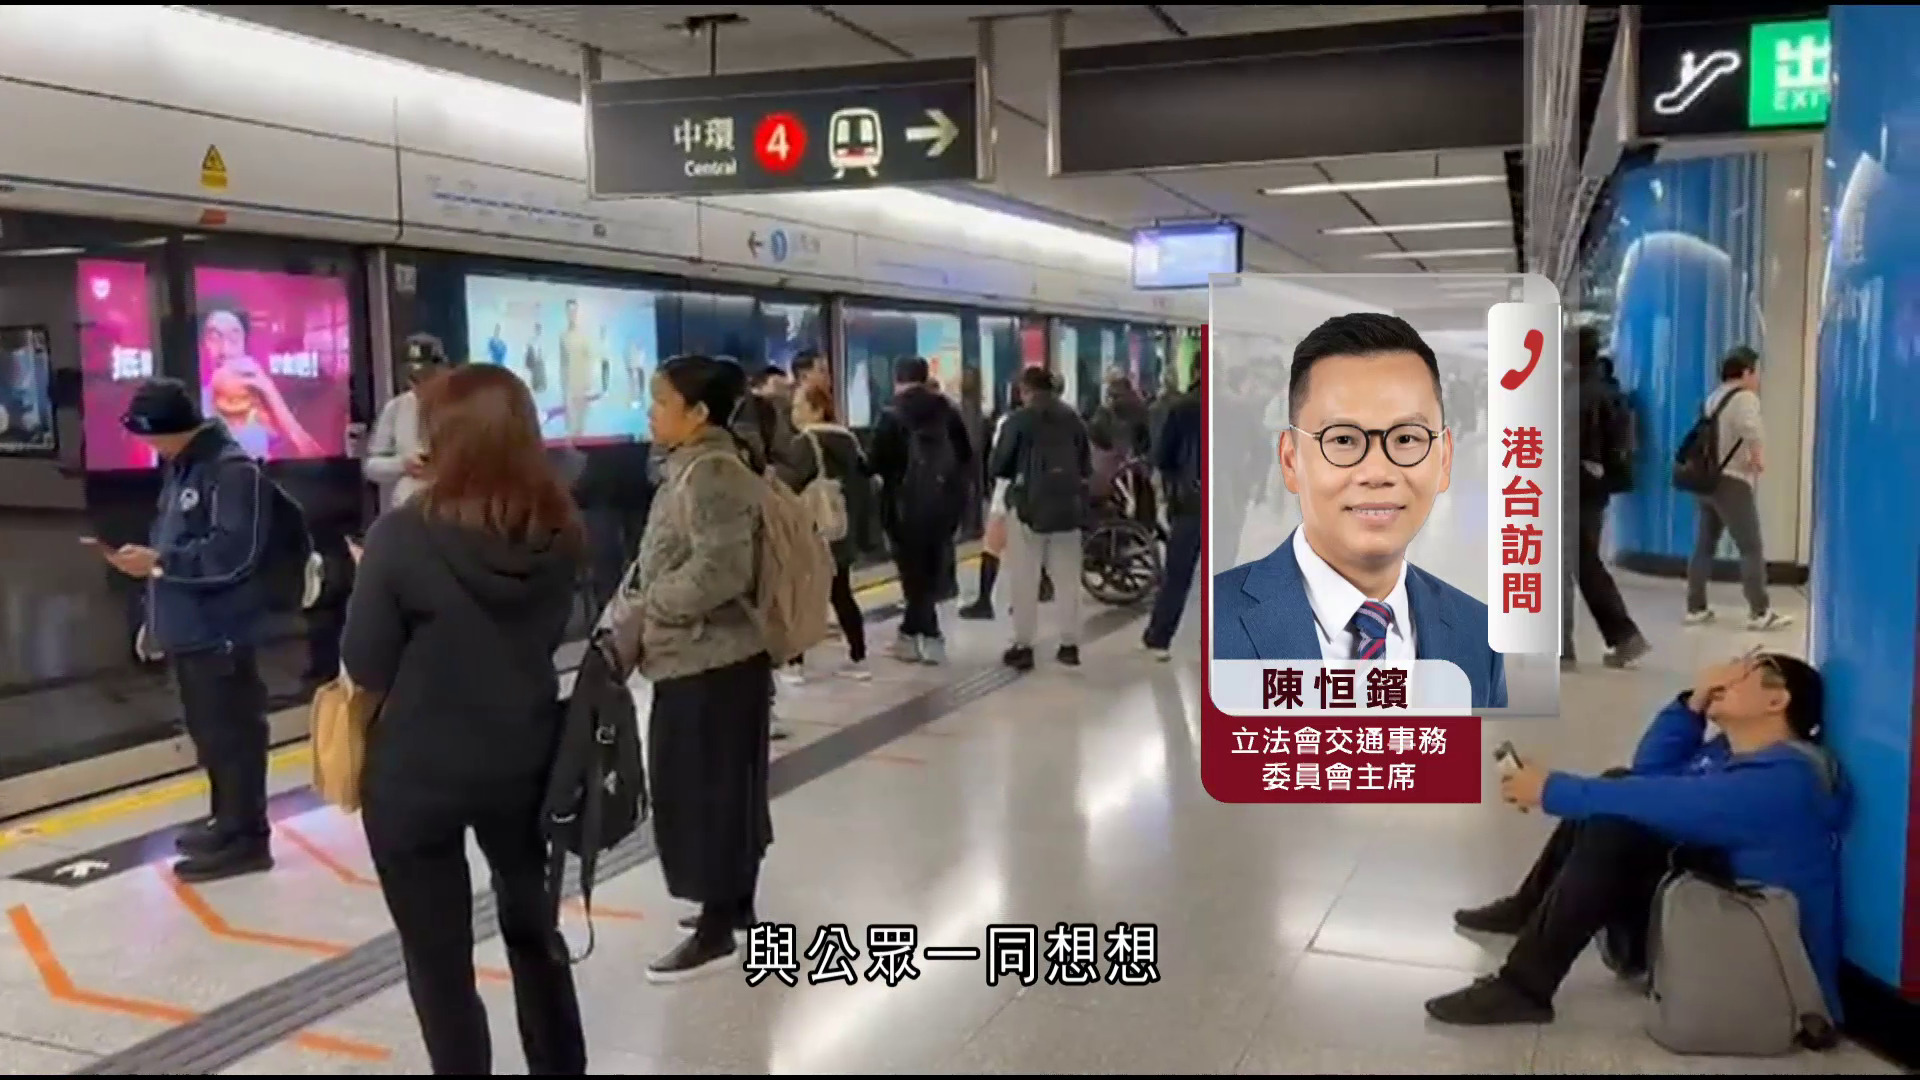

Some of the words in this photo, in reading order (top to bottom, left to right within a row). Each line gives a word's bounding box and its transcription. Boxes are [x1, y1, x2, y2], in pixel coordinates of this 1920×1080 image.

[673, 117, 735, 153] 中環
[766, 123, 791, 161] 4
[684, 158, 737, 177] Central
